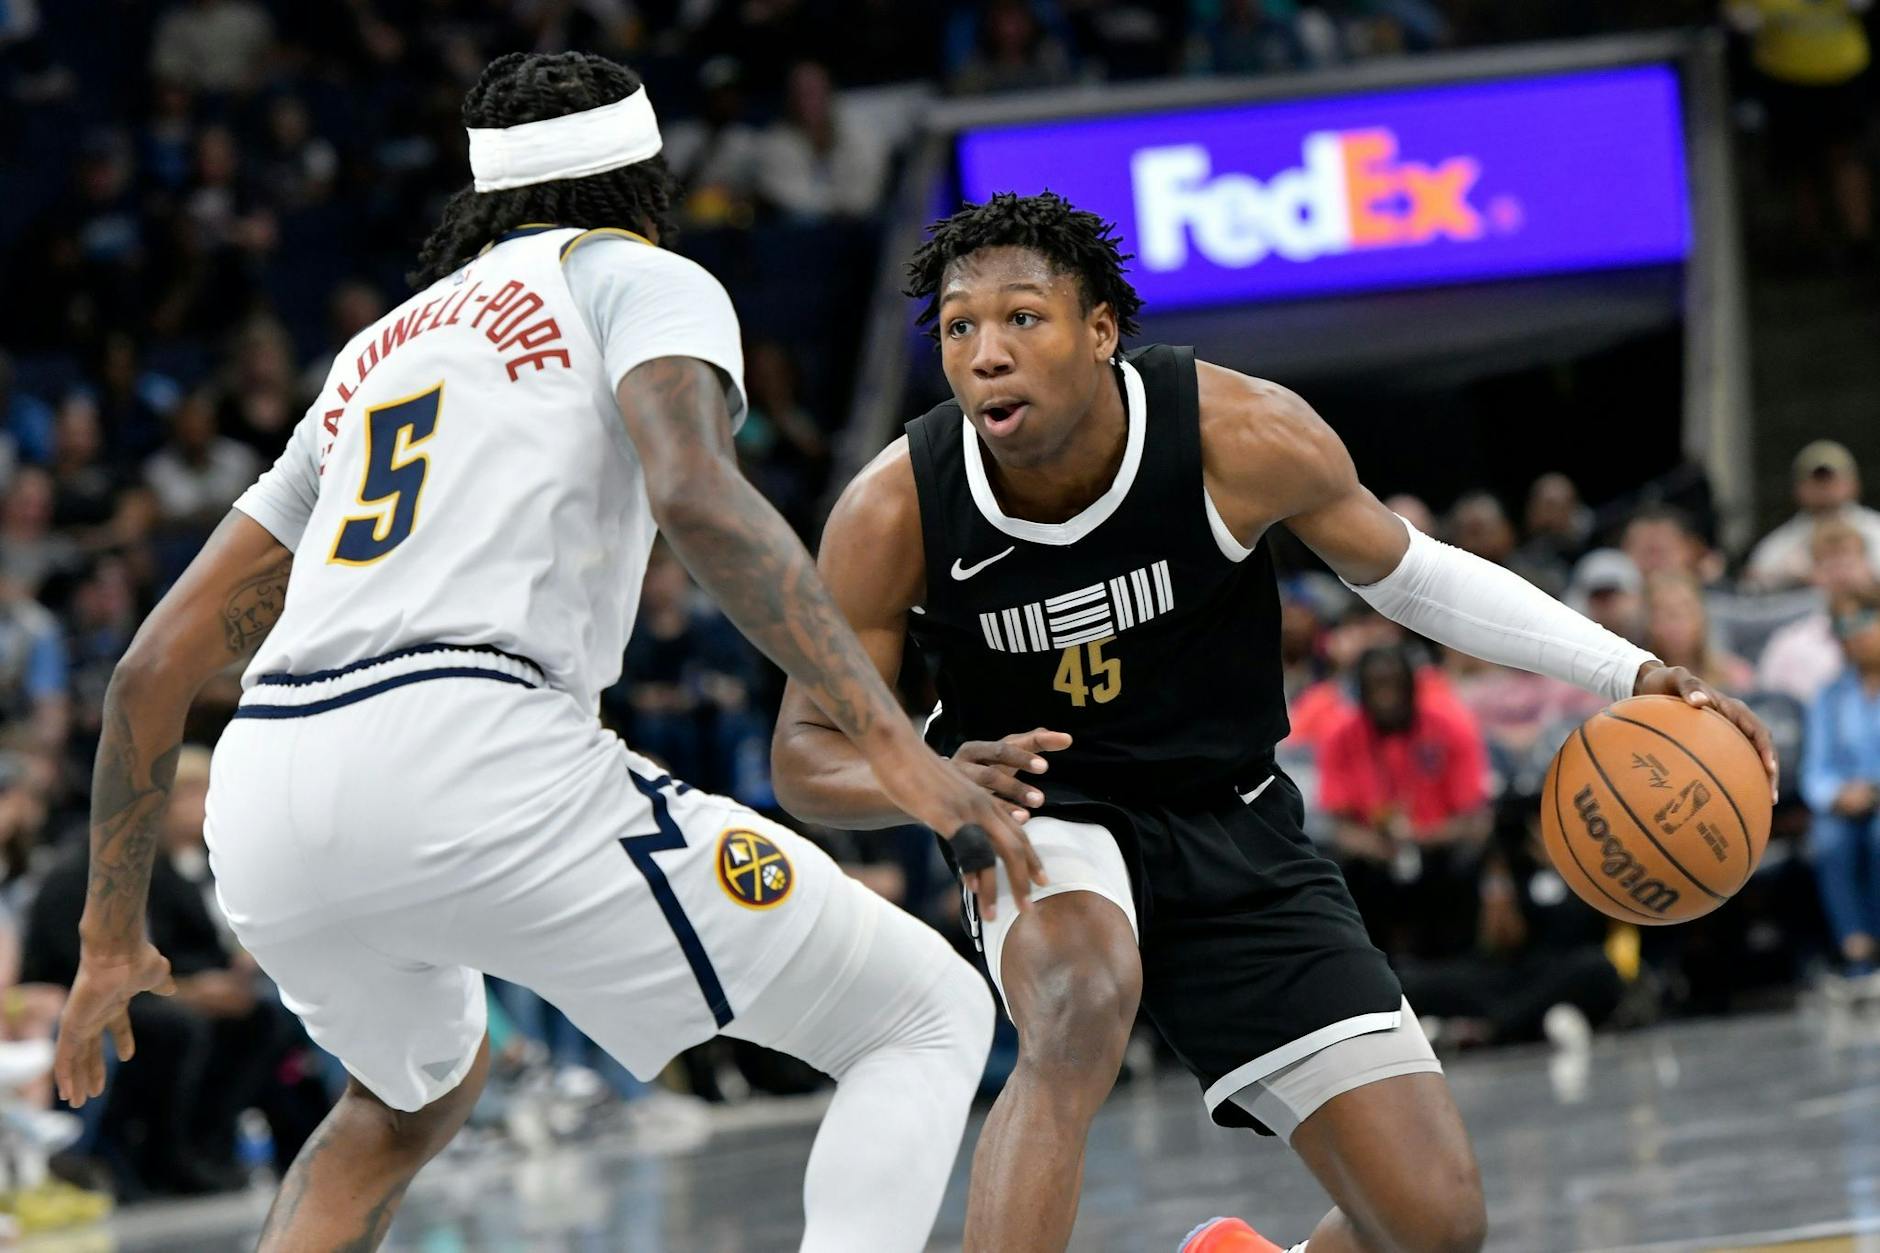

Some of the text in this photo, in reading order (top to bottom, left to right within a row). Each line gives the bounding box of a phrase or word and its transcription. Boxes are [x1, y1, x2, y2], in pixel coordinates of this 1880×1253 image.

[1132, 128, 1482, 271] FedEx
[326, 378, 445, 567] 5
[1053, 635, 1122, 707] 45
[1573, 783, 1681, 913] Wilson
